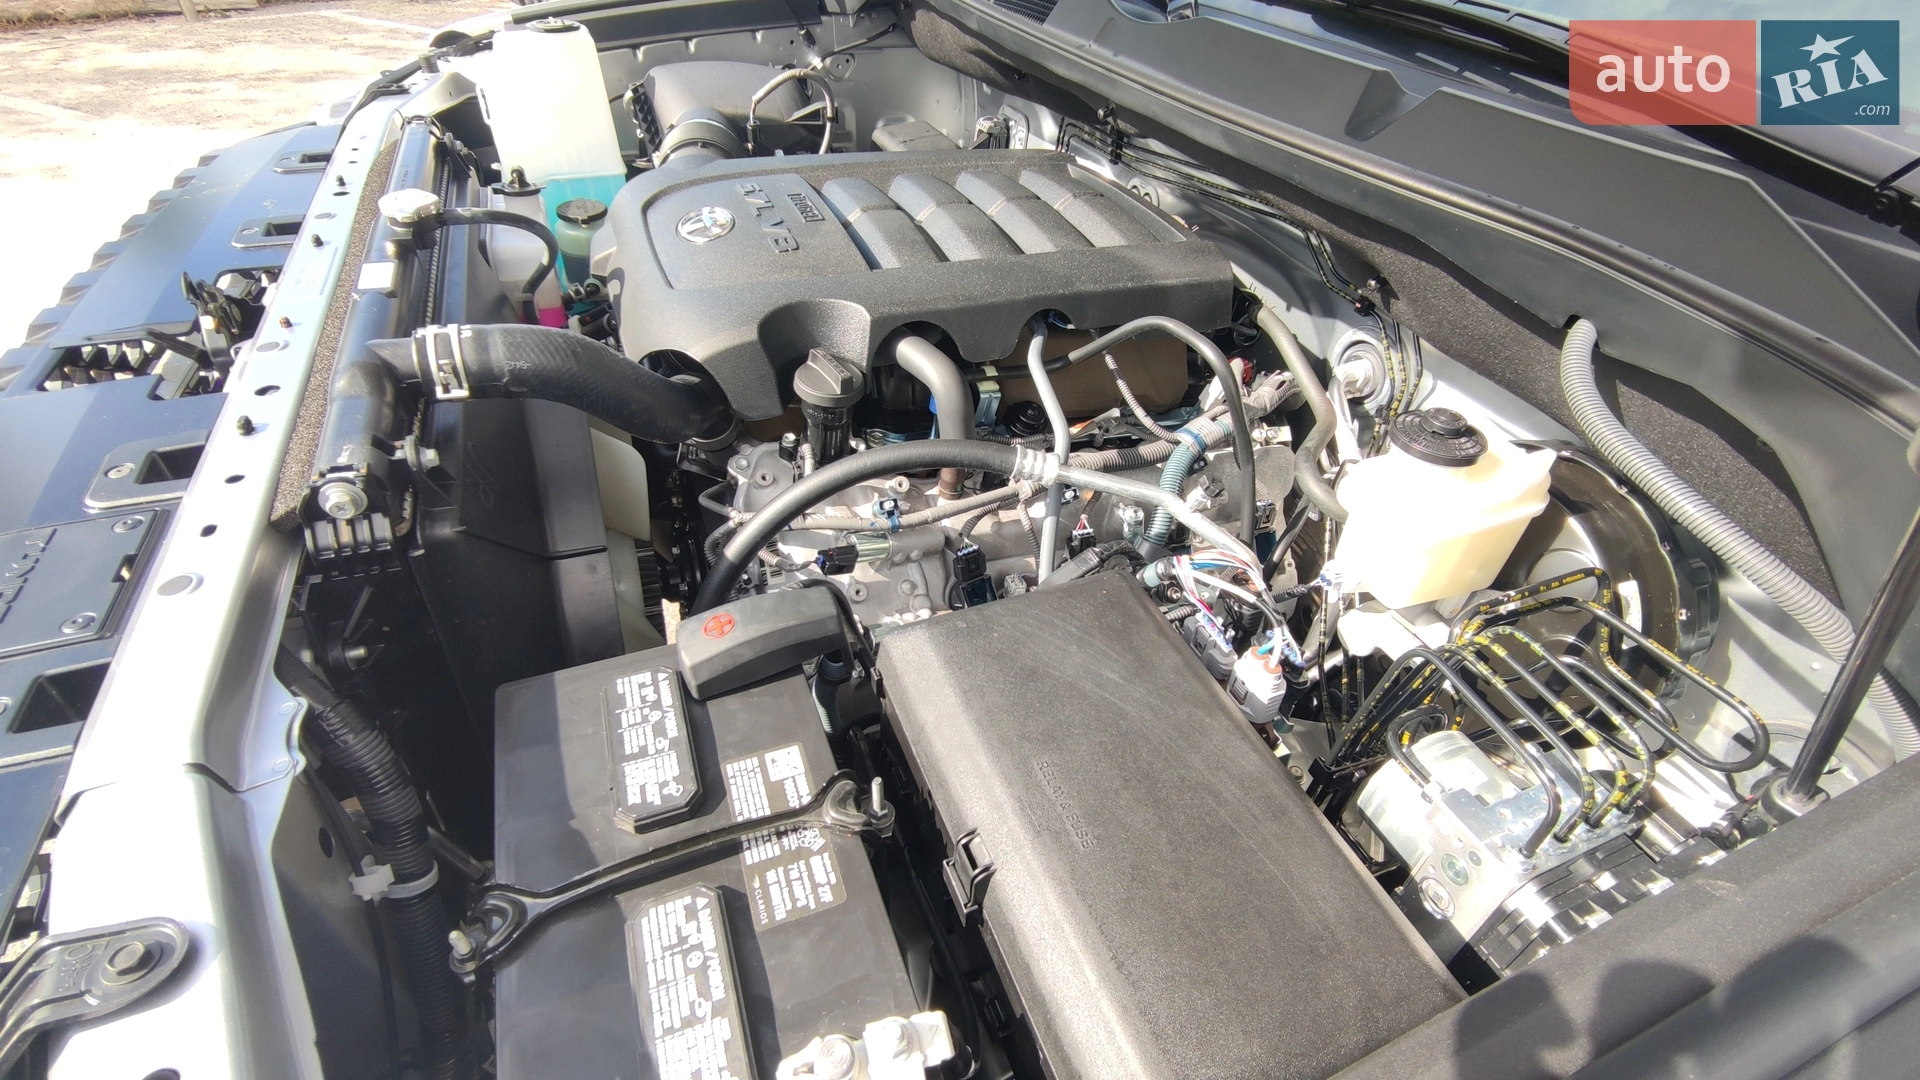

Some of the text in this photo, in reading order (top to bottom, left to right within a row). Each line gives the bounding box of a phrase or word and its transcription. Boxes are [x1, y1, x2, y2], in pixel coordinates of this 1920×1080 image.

[761, 217, 800, 254] V8
[1036, 760, 1094, 849] RELAY & FUSE
[754, 888, 768, 925] CLARIOS
